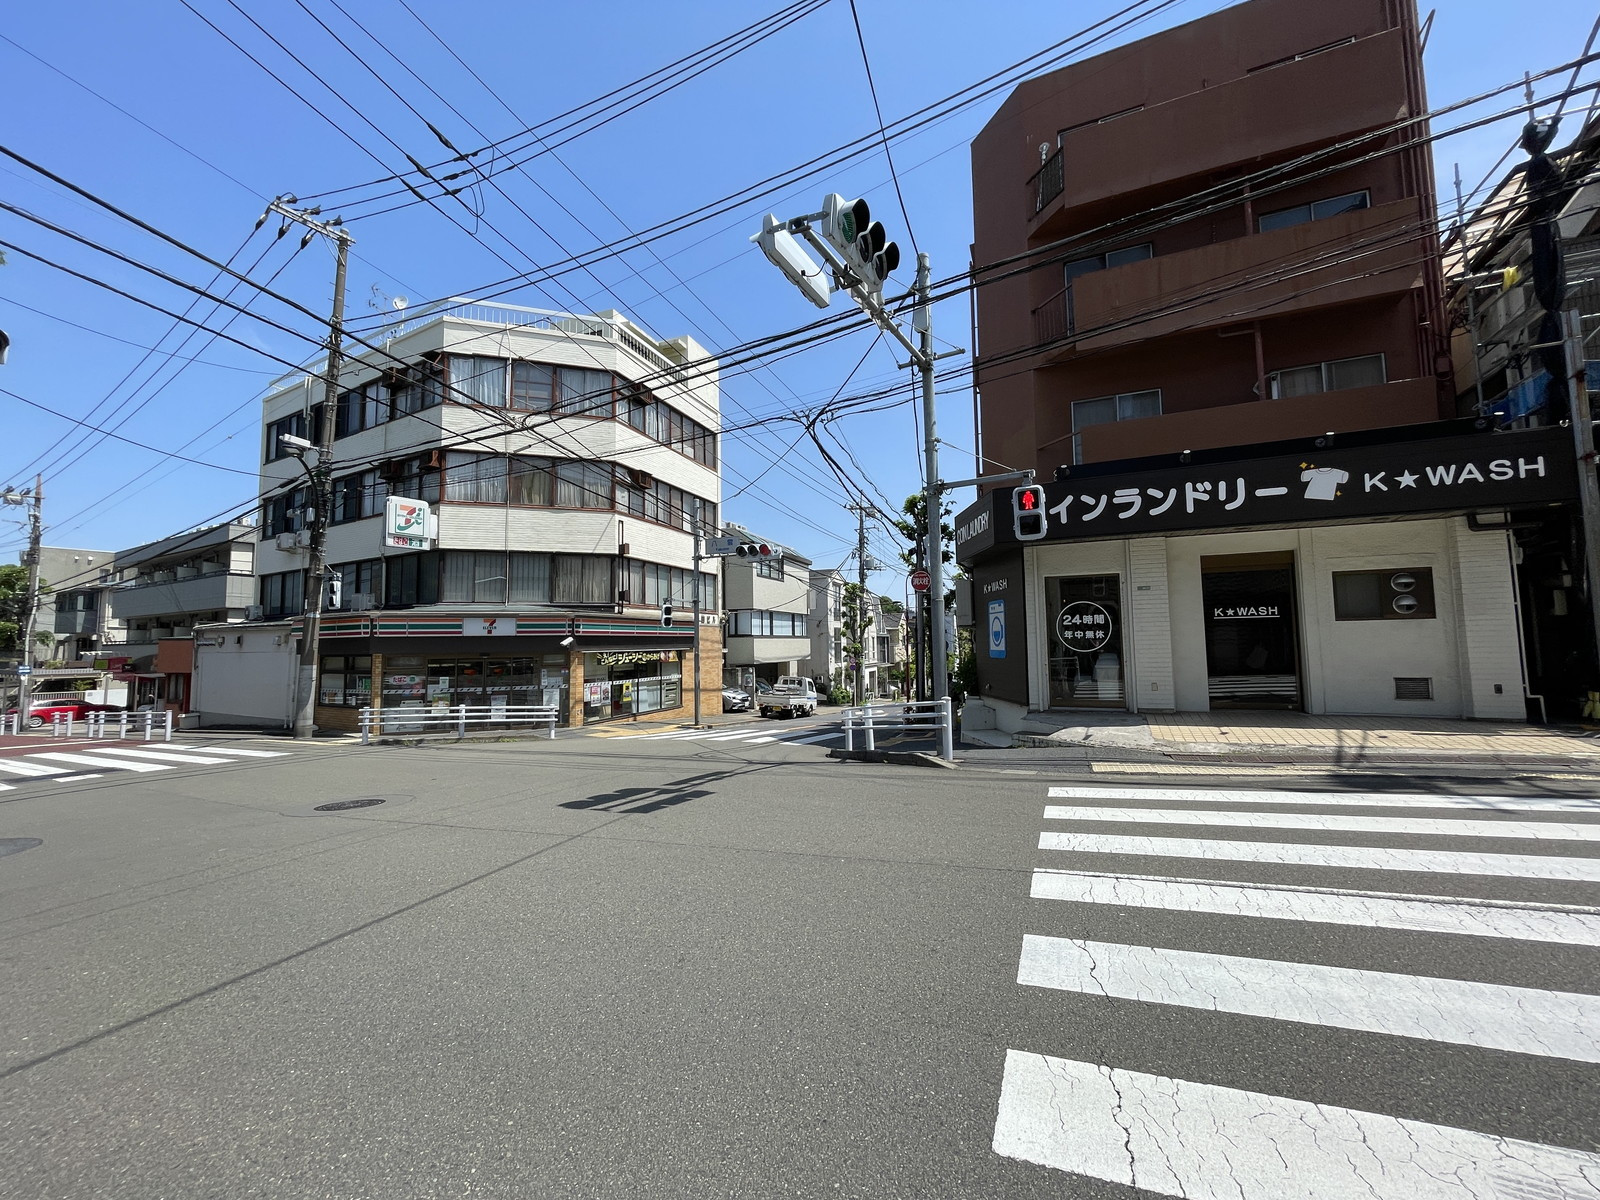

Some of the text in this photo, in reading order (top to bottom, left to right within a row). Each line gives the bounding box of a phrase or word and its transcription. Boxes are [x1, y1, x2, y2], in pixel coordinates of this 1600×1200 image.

[1049, 477, 1288, 524] インランドリー
[967, 510, 990, 540] LAUNDRY
[1062, 614, 1105, 626] 24時間
[1063, 630, 1105, 639] 年中無休
